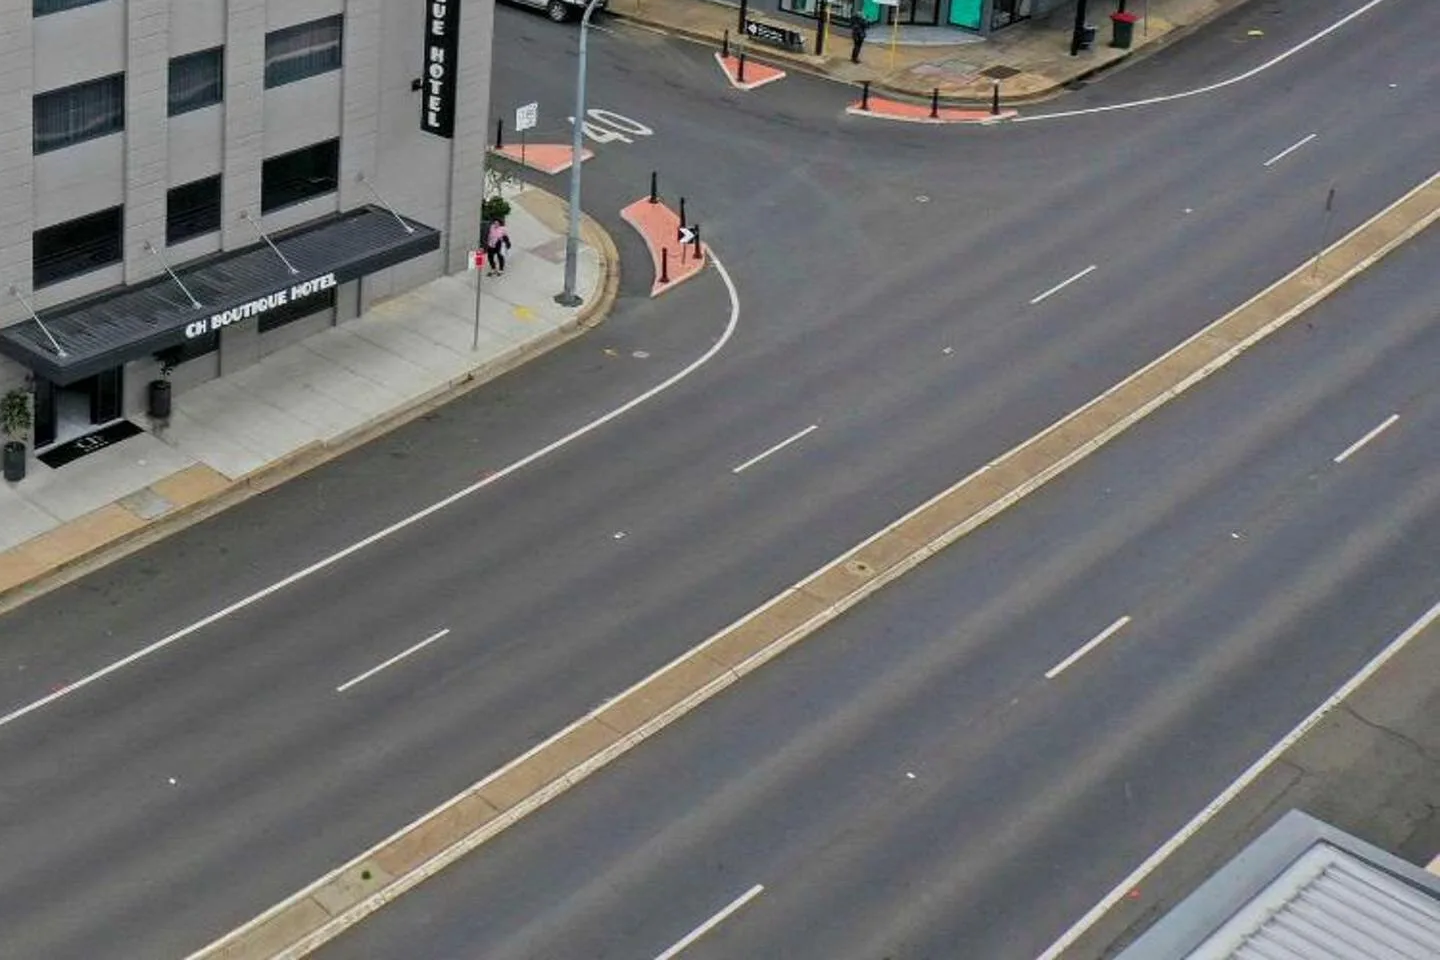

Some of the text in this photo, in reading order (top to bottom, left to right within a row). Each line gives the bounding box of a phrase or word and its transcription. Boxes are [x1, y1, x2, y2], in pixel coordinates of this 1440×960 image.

[427, 46, 444, 128] HOTEL
[567, 108, 654, 144] 40
[185, 272, 337, 339] CH BOUTIQUE HOTEL
